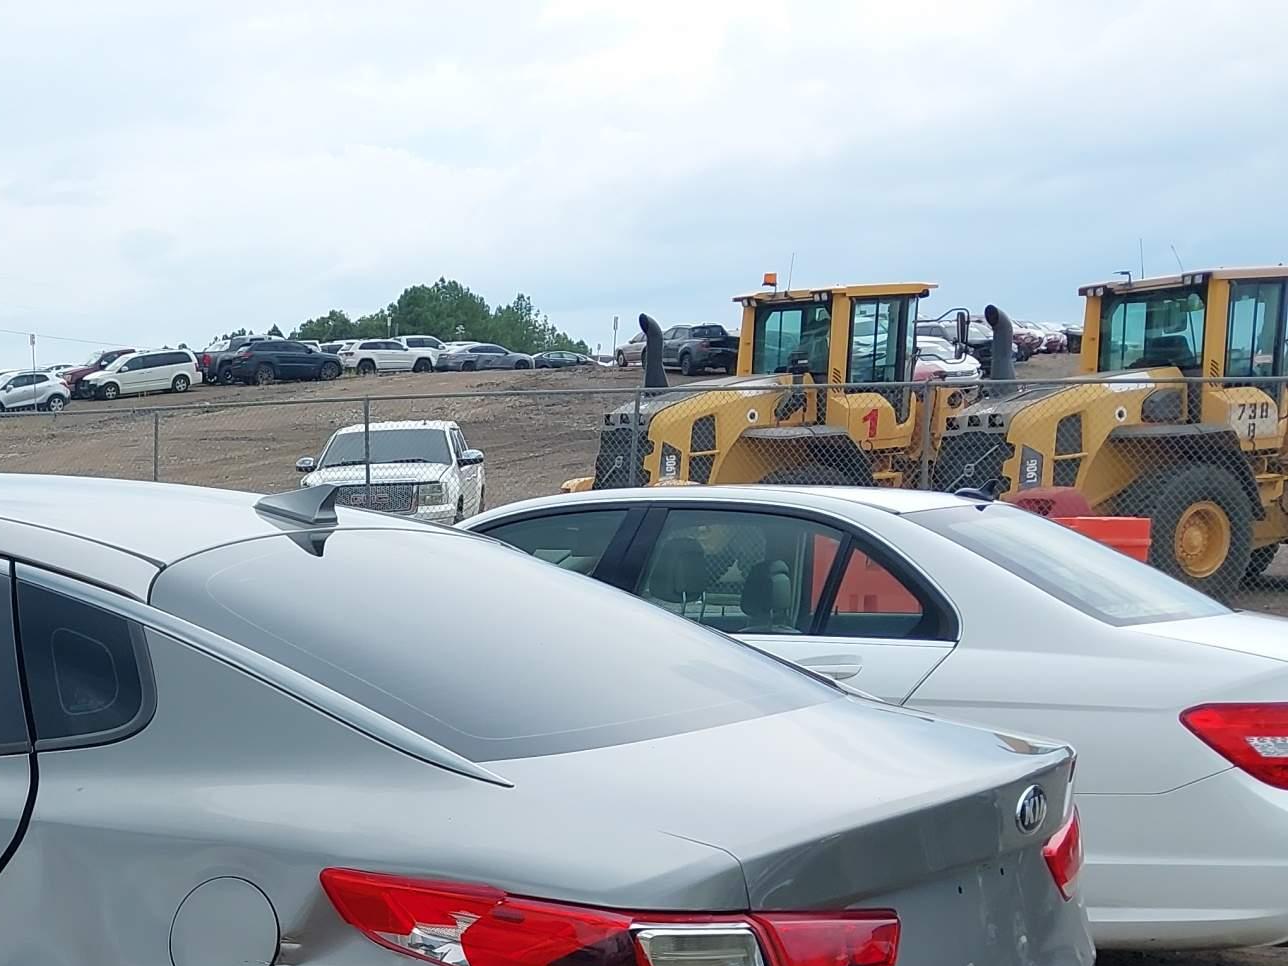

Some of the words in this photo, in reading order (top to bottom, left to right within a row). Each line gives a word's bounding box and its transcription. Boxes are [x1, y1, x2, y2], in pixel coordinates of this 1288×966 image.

[862, 408, 879, 438] 1
[665, 454, 677, 476] L90G
[1026, 459, 1038, 483] L90G
[1024, 794, 1044, 826] KIA
